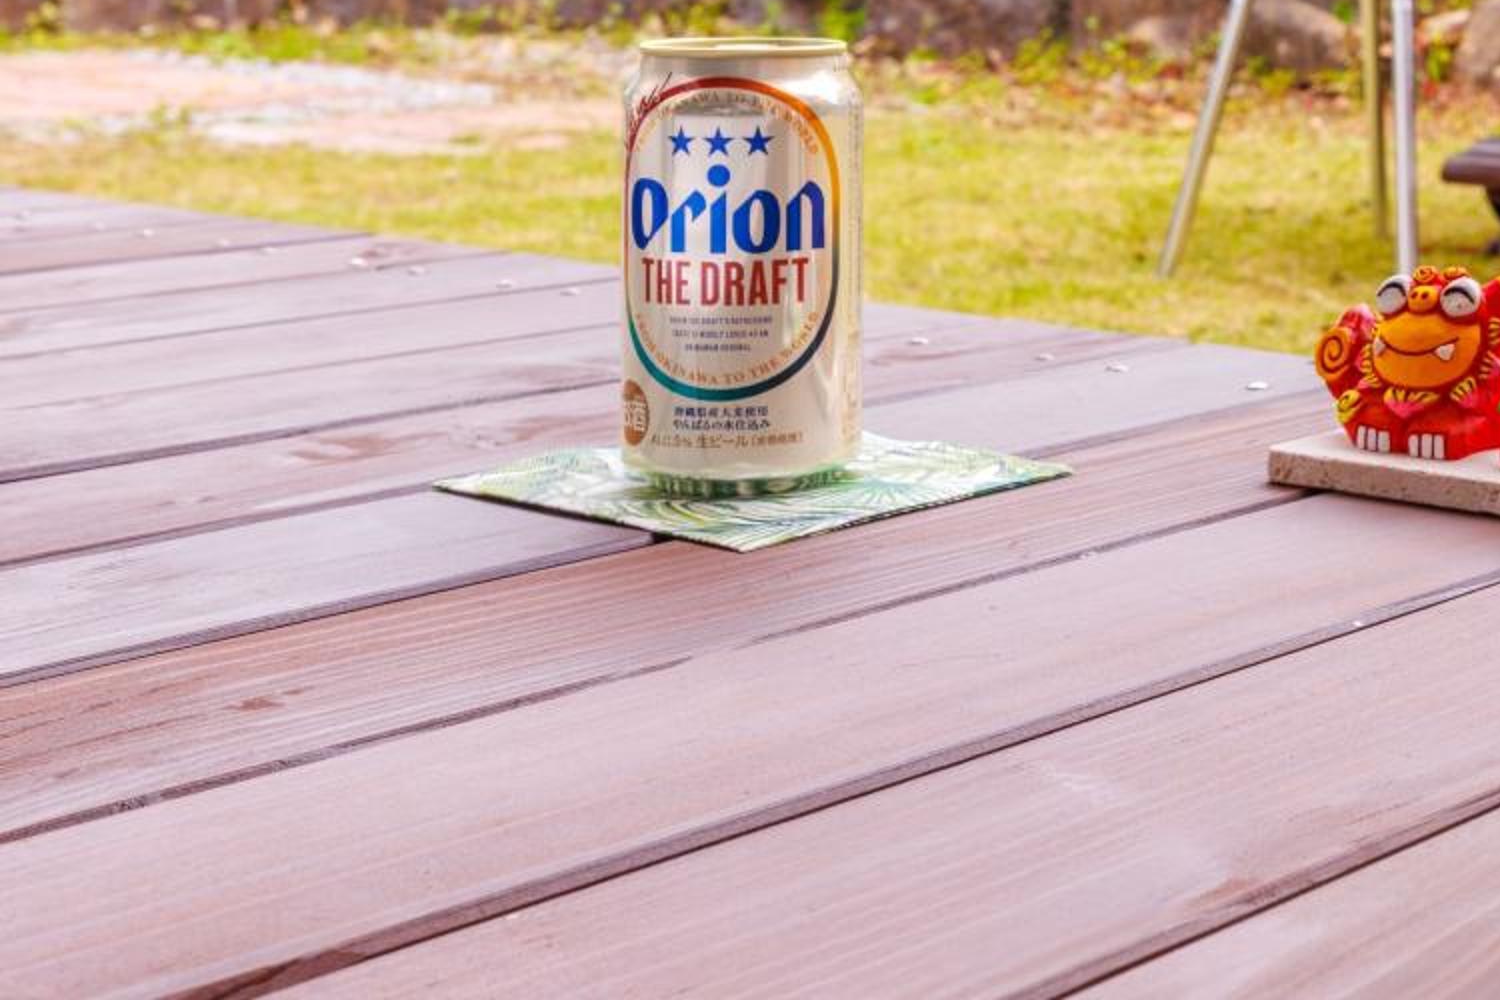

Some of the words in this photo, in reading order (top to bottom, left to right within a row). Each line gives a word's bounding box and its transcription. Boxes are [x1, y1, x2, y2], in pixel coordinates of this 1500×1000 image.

[632, 164, 825, 254] Orion
[642, 257, 691, 305] THE
[701, 257, 809, 306] DRAFT
